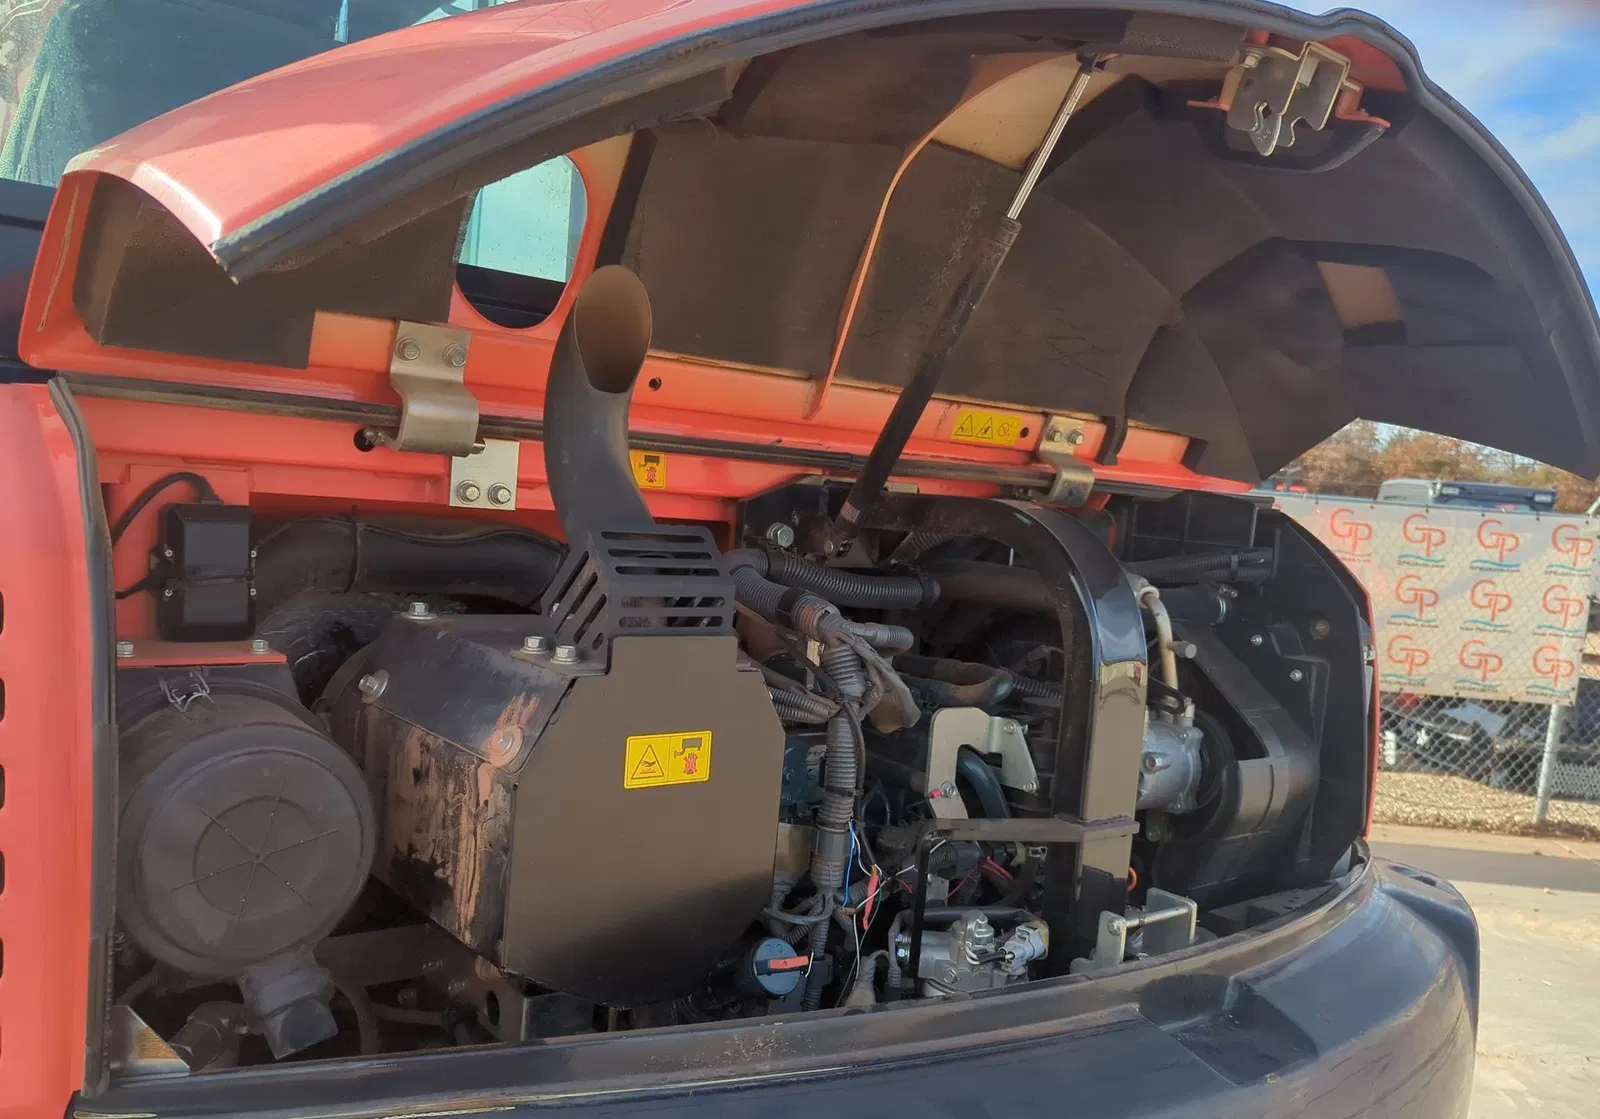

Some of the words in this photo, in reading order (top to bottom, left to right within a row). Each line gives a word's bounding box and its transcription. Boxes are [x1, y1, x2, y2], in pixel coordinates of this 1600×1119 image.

[1329, 508, 1373, 552] GP
[1402, 513, 1447, 557] GP
[1477, 519, 1520, 562] GP
[1552, 523, 1594, 566] GP
[1394, 574, 1440, 618] GP
[1471, 580, 1513, 621] GP
[1542, 584, 1585, 626] GP
[1387, 634, 1430, 677] GP
[1458, 640, 1503, 682] GP
[1532, 644, 1576, 687] GP
